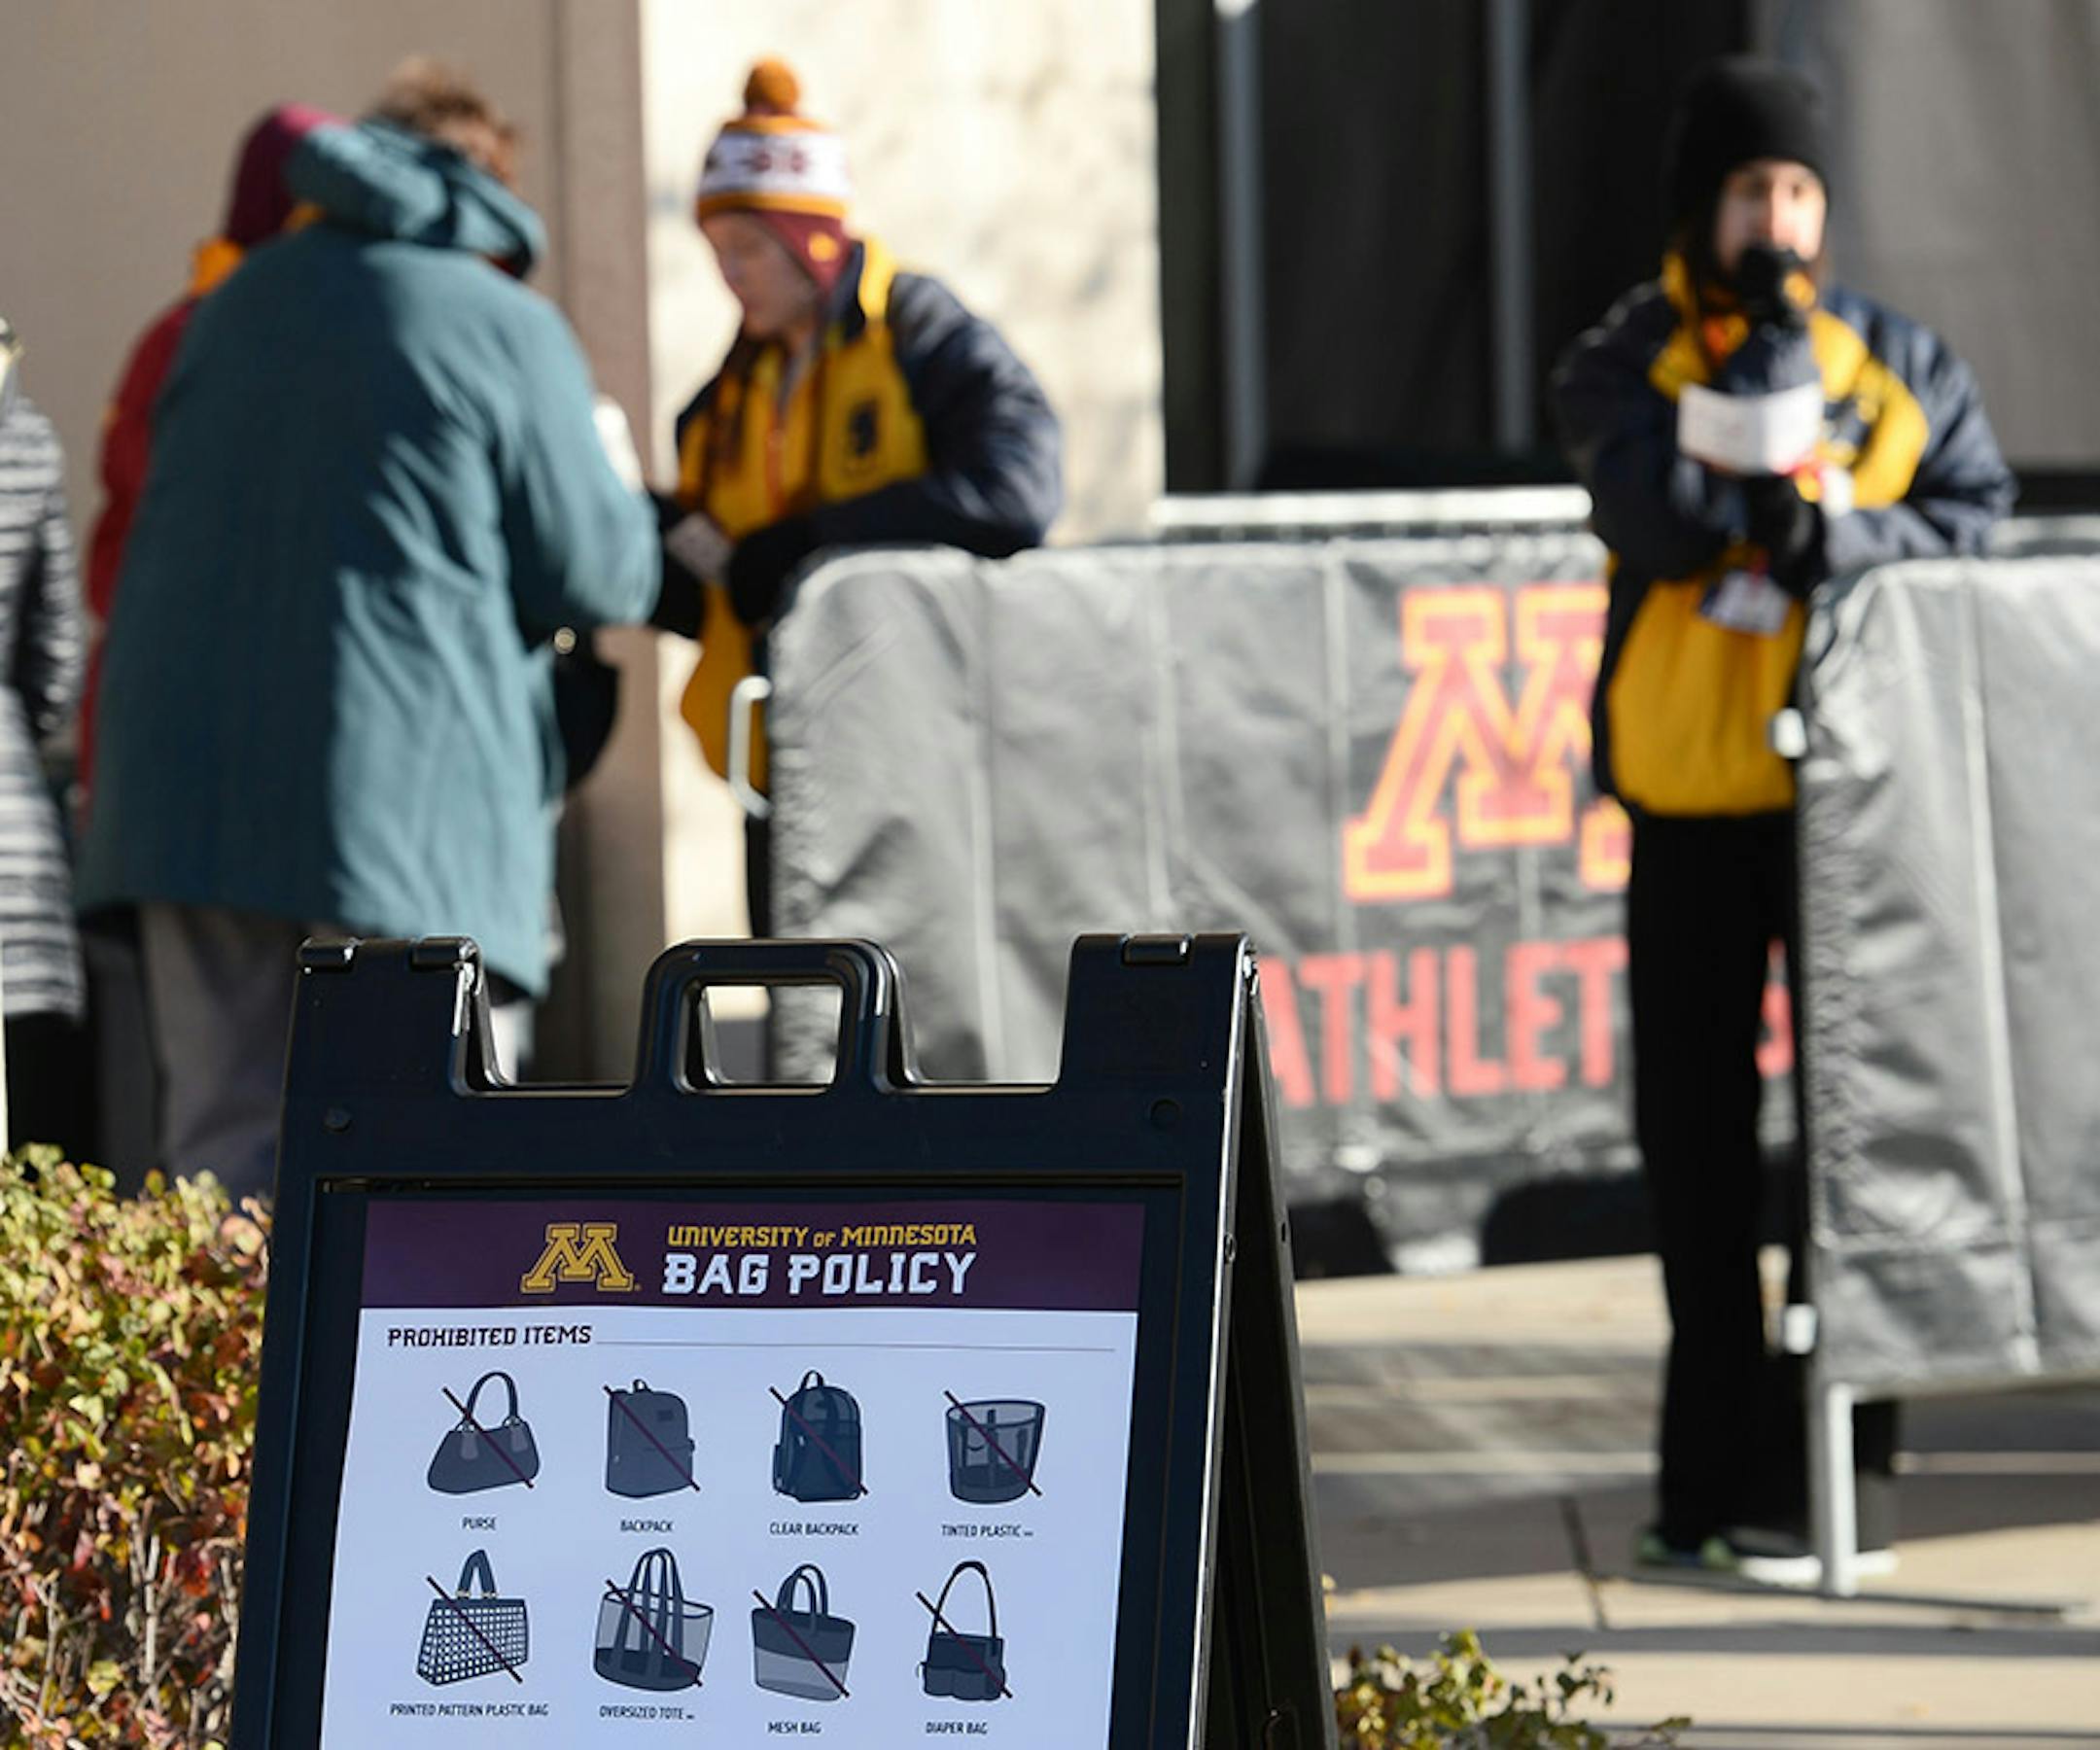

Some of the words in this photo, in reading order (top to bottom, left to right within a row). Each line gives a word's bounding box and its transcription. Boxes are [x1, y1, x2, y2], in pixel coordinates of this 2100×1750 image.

[1257, 935, 1796, 1106] ATHLET
[667, 1225, 809, 1247] UNIVERSITY
[841, 1224, 977, 1246] MINNESOTA
[662, 1252, 770, 1295] BAG
[788, 1251, 977, 1295] POLICY
[388, 1327, 516, 1348] PROHIBITED
[522, 1325, 592, 1345] ITEMS
[462, 1517, 497, 1531] PURSE
[619, 1520, 673, 1533] BACKPACK
[769, 1522, 803, 1536] CLEAR
[805, 1523, 859, 1536] BACKPACK
[941, 1523, 978, 1537] TINTED
[980, 1524, 1022, 1538] PLASTIC
[390, 1703, 436, 1716] PRINTED
[438, 1703, 483, 1717] PATTERN
[486, 1703, 525, 1717] PLASTIC
[528, 1703, 549, 1716] BAG
[599, 1705, 657, 1719] OVERSIZED
[660, 1707, 684, 1720] TOTE
[768, 1721, 798, 1734] MESH
[800, 1722, 822, 1734] BAG
[926, 1721, 964, 1734] DIAPER
[966, 1722, 988, 1734] BAG
